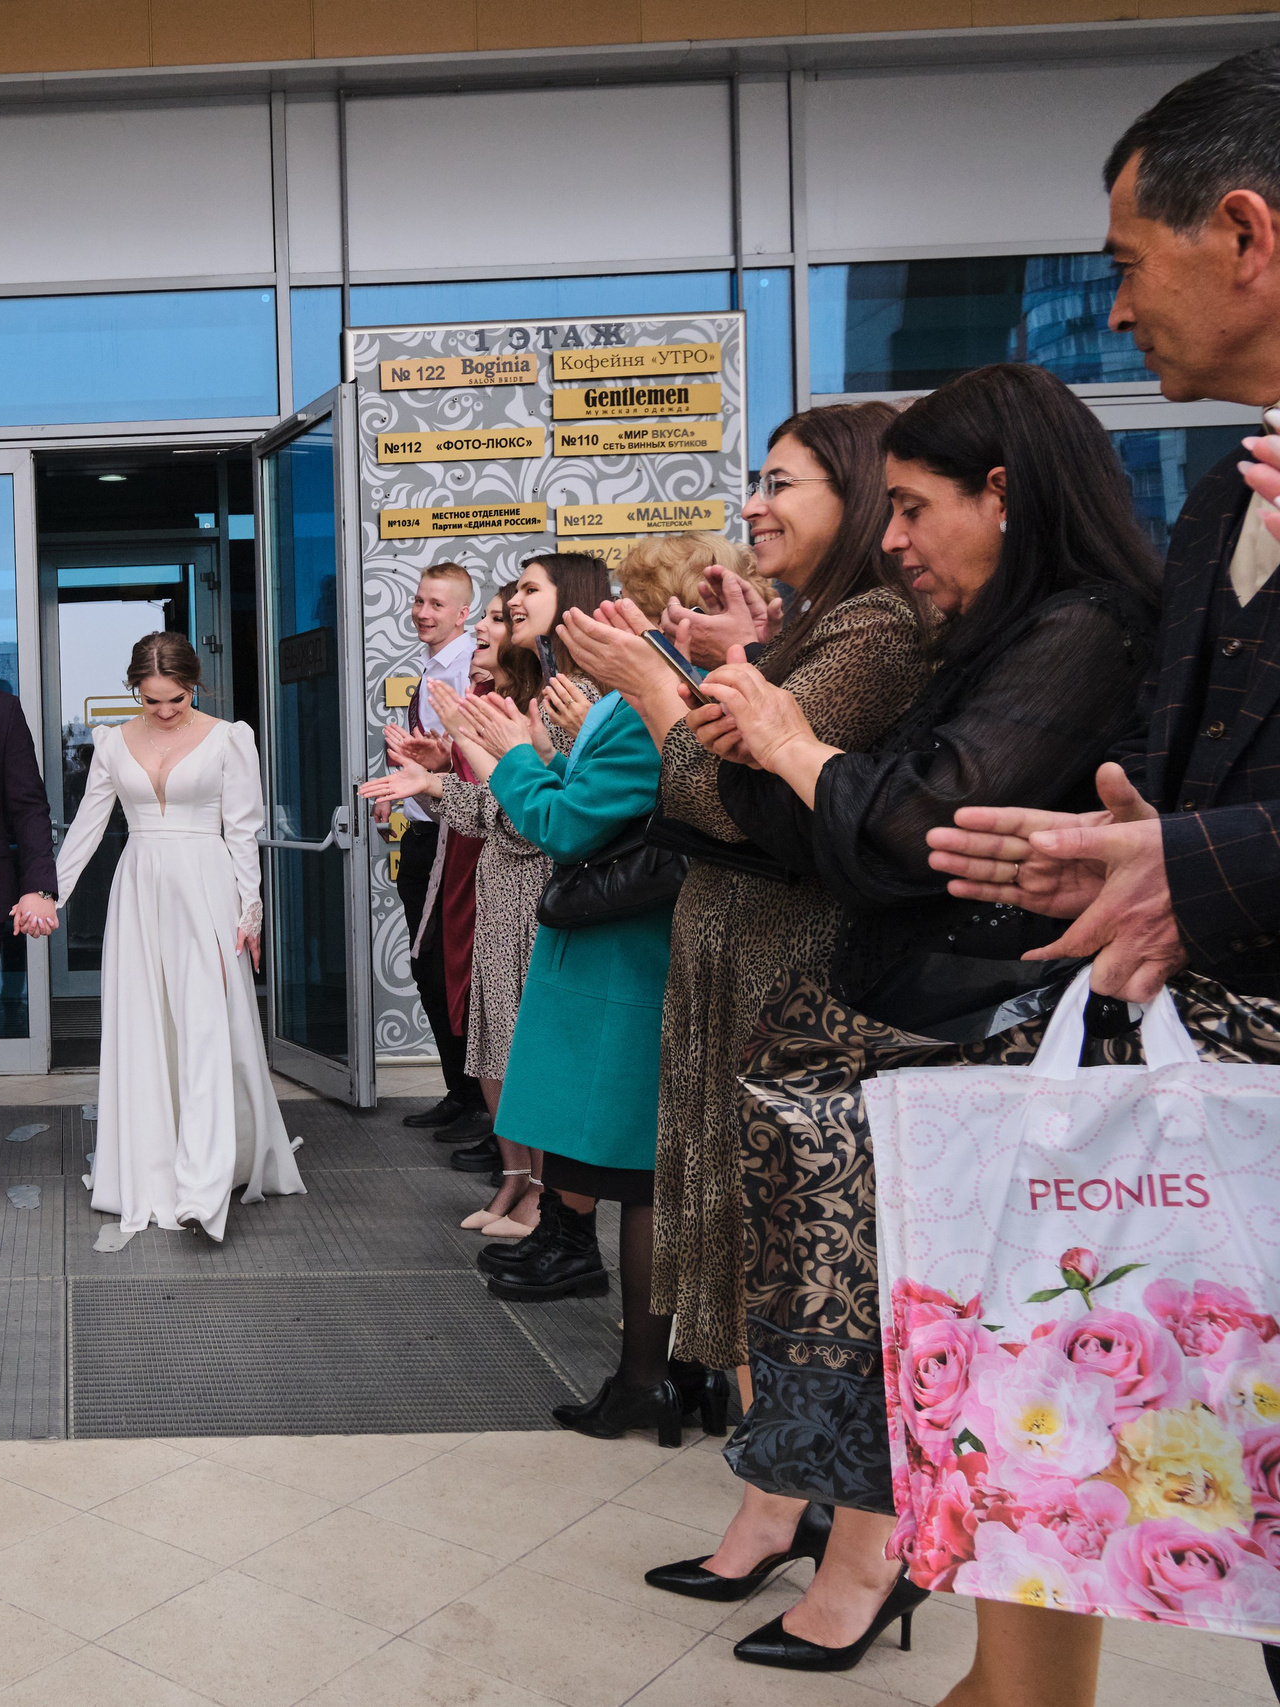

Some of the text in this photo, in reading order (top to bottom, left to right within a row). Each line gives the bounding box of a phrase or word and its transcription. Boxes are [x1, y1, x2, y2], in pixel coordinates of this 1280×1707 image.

[475, 323, 626, 352] 1 ЭТАЖ
[560, 348, 715, 373] Кофейня «УТРО»
[391, 355, 531, 383] № 122 Boginia
[468, 376, 524, 385] SALON BRIDE
[584, 386, 690, 408] Gentlemen
[585, 405, 690, 416] мужская одежда
[561, 434, 599, 447] №110
[618, 428, 695, 440] «МИР ВКУСА»
[384, 436, 533, 454] №112 «ФОТО-ЛЮКС»
[602, 439, 708, 450] СЕТЬ ВИННЫХ БУТИКОВ
[431, 507, 521, 520] МЕСТНОЕ ОТДЕЛЕНИЕ
[563, 513, 603, 527] №122
[626, 505, 712, 522] «MALINA»
[387, 519, 420, 528] №103/4
[432, 516, 542, 531] Партии «ЕДИНАЯ РОССИЯ»
[646, 519, 693, 528] МАСТЕРСКАЯ
[1028, 1173, 1211, 1212] PEONIES
